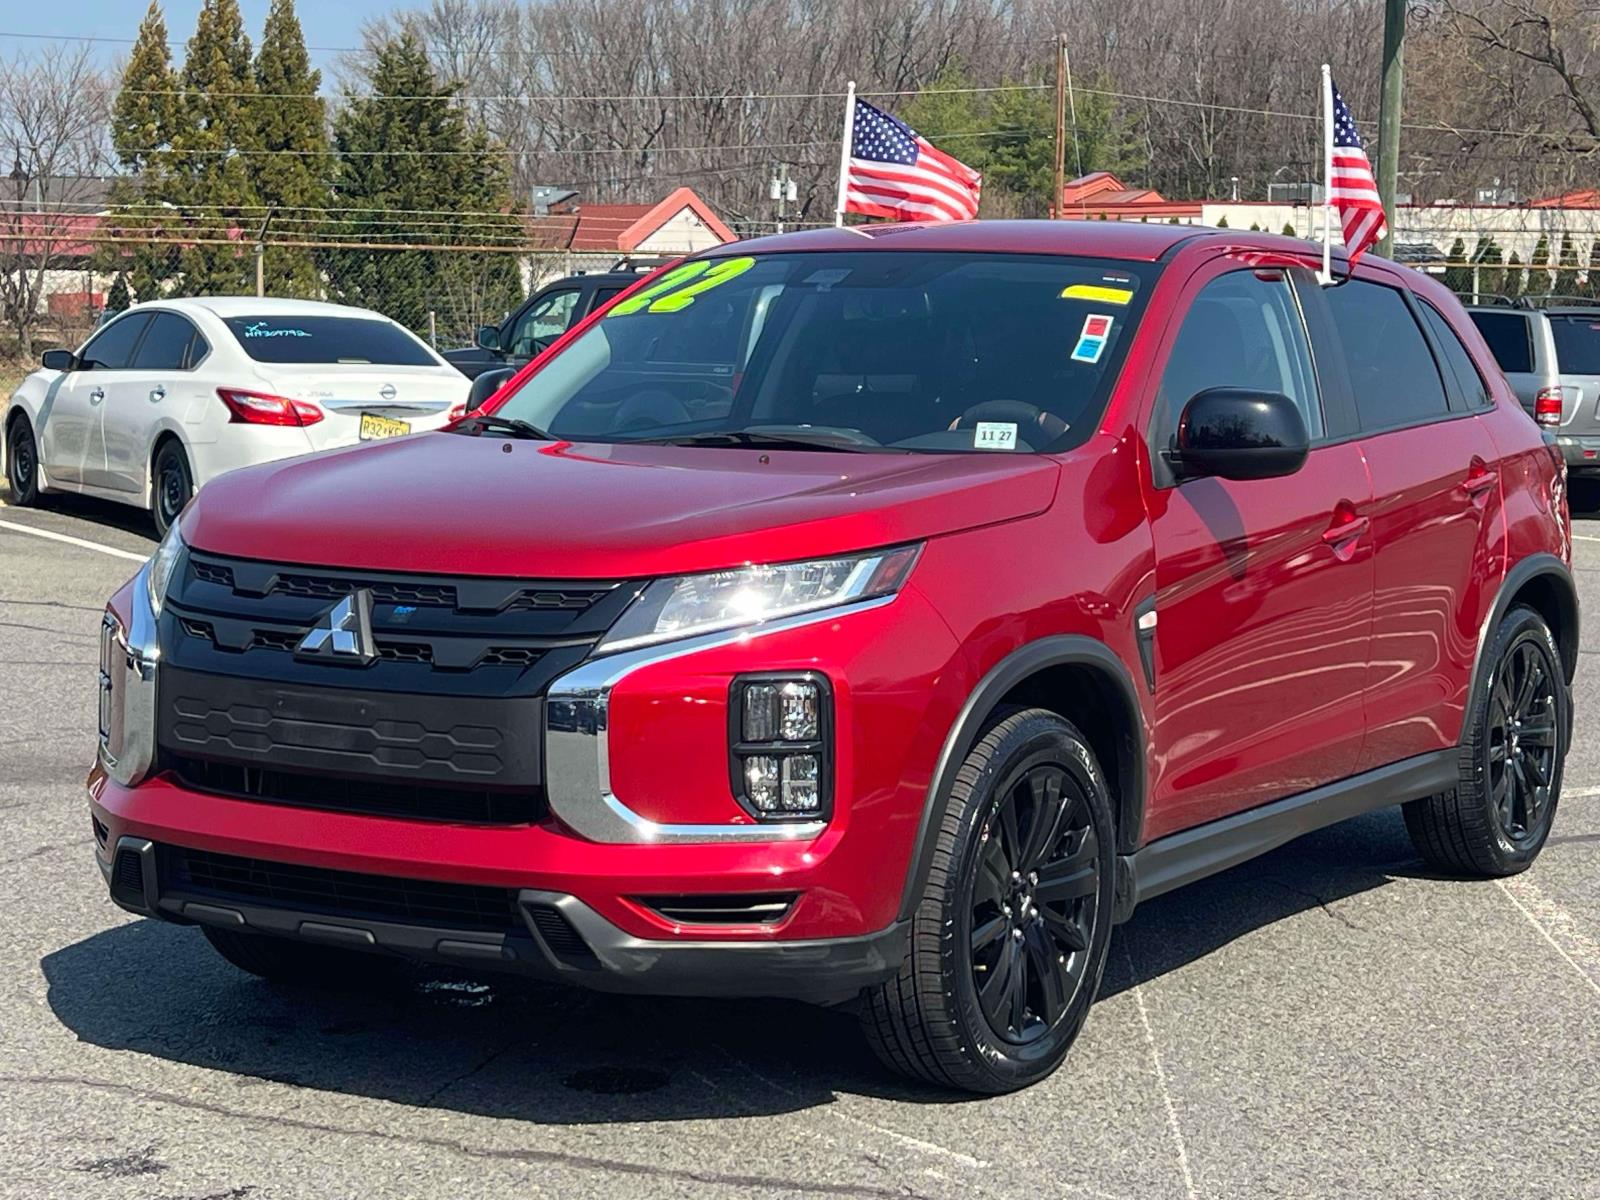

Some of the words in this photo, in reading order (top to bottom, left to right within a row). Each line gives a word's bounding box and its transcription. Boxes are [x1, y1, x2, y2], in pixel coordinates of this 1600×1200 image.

[608, 257, 757, 317] 22
[981, 430, 994, 441] 11
[998, 430, 1012, 441] 27
